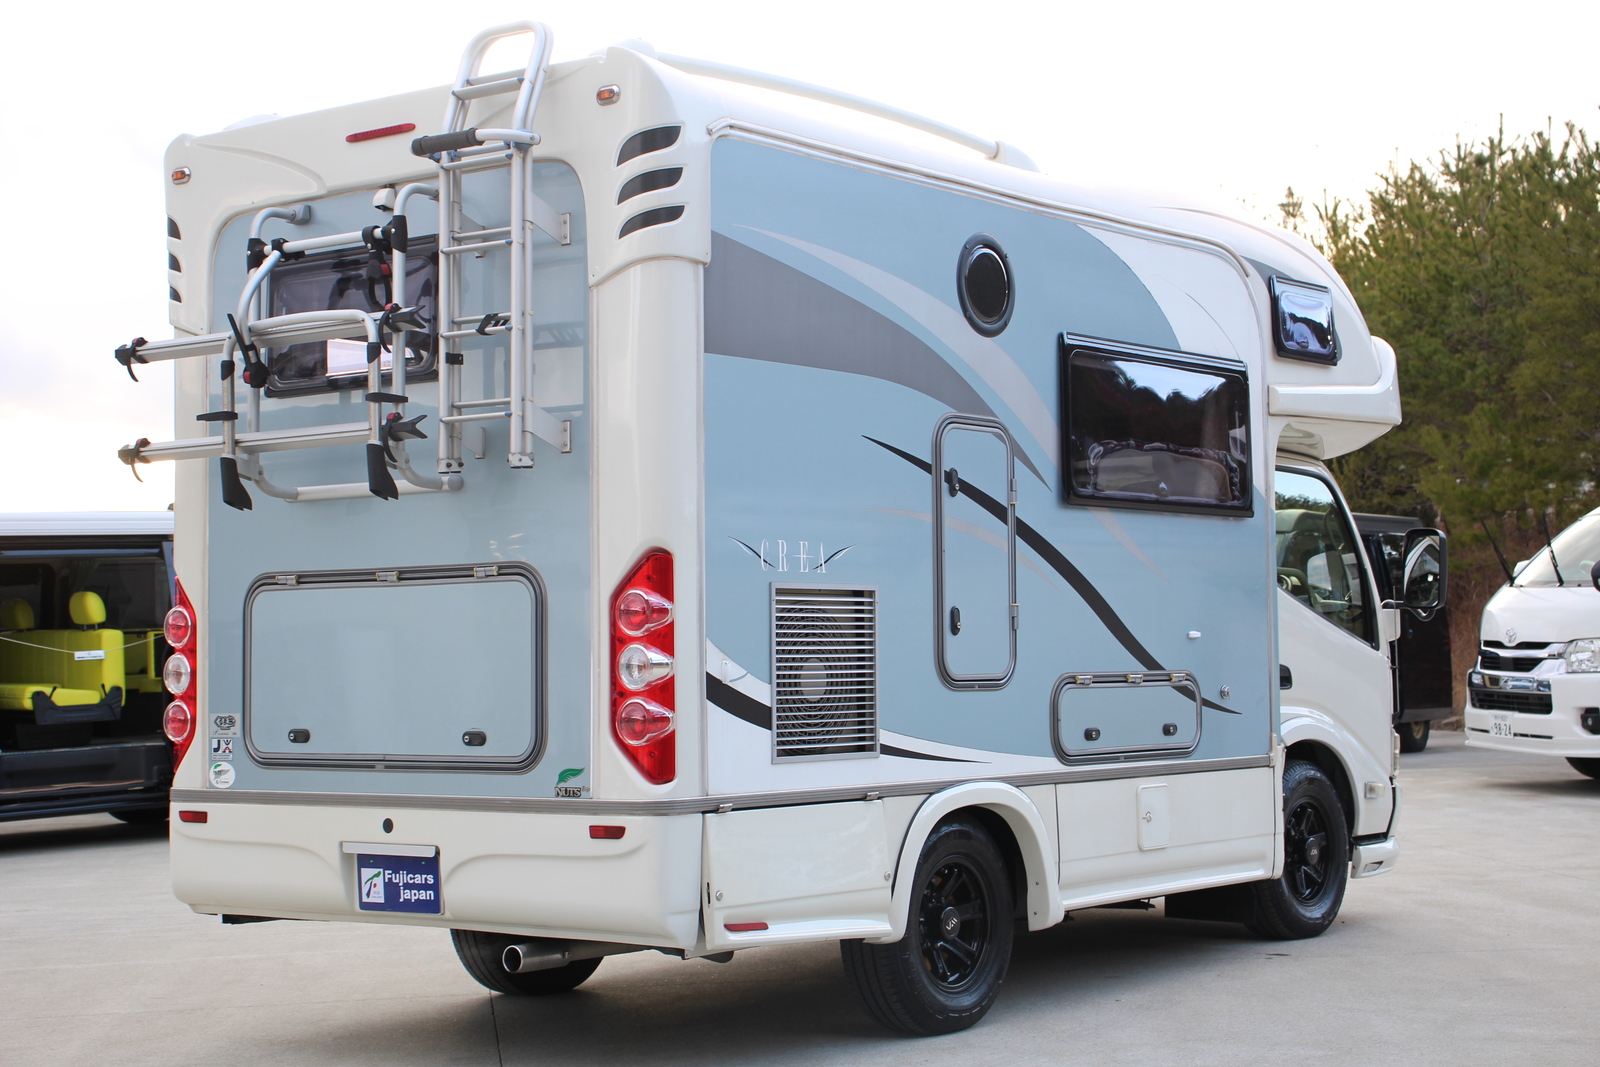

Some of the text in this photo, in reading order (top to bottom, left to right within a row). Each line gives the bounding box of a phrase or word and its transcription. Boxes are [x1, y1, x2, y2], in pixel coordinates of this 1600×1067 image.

[760, 538, 827, 574] CREA
[554, 786, 582, 798] NUTS
[384, 870, 434, 886] Fujicars
[399, 887, 434, 902] japan
